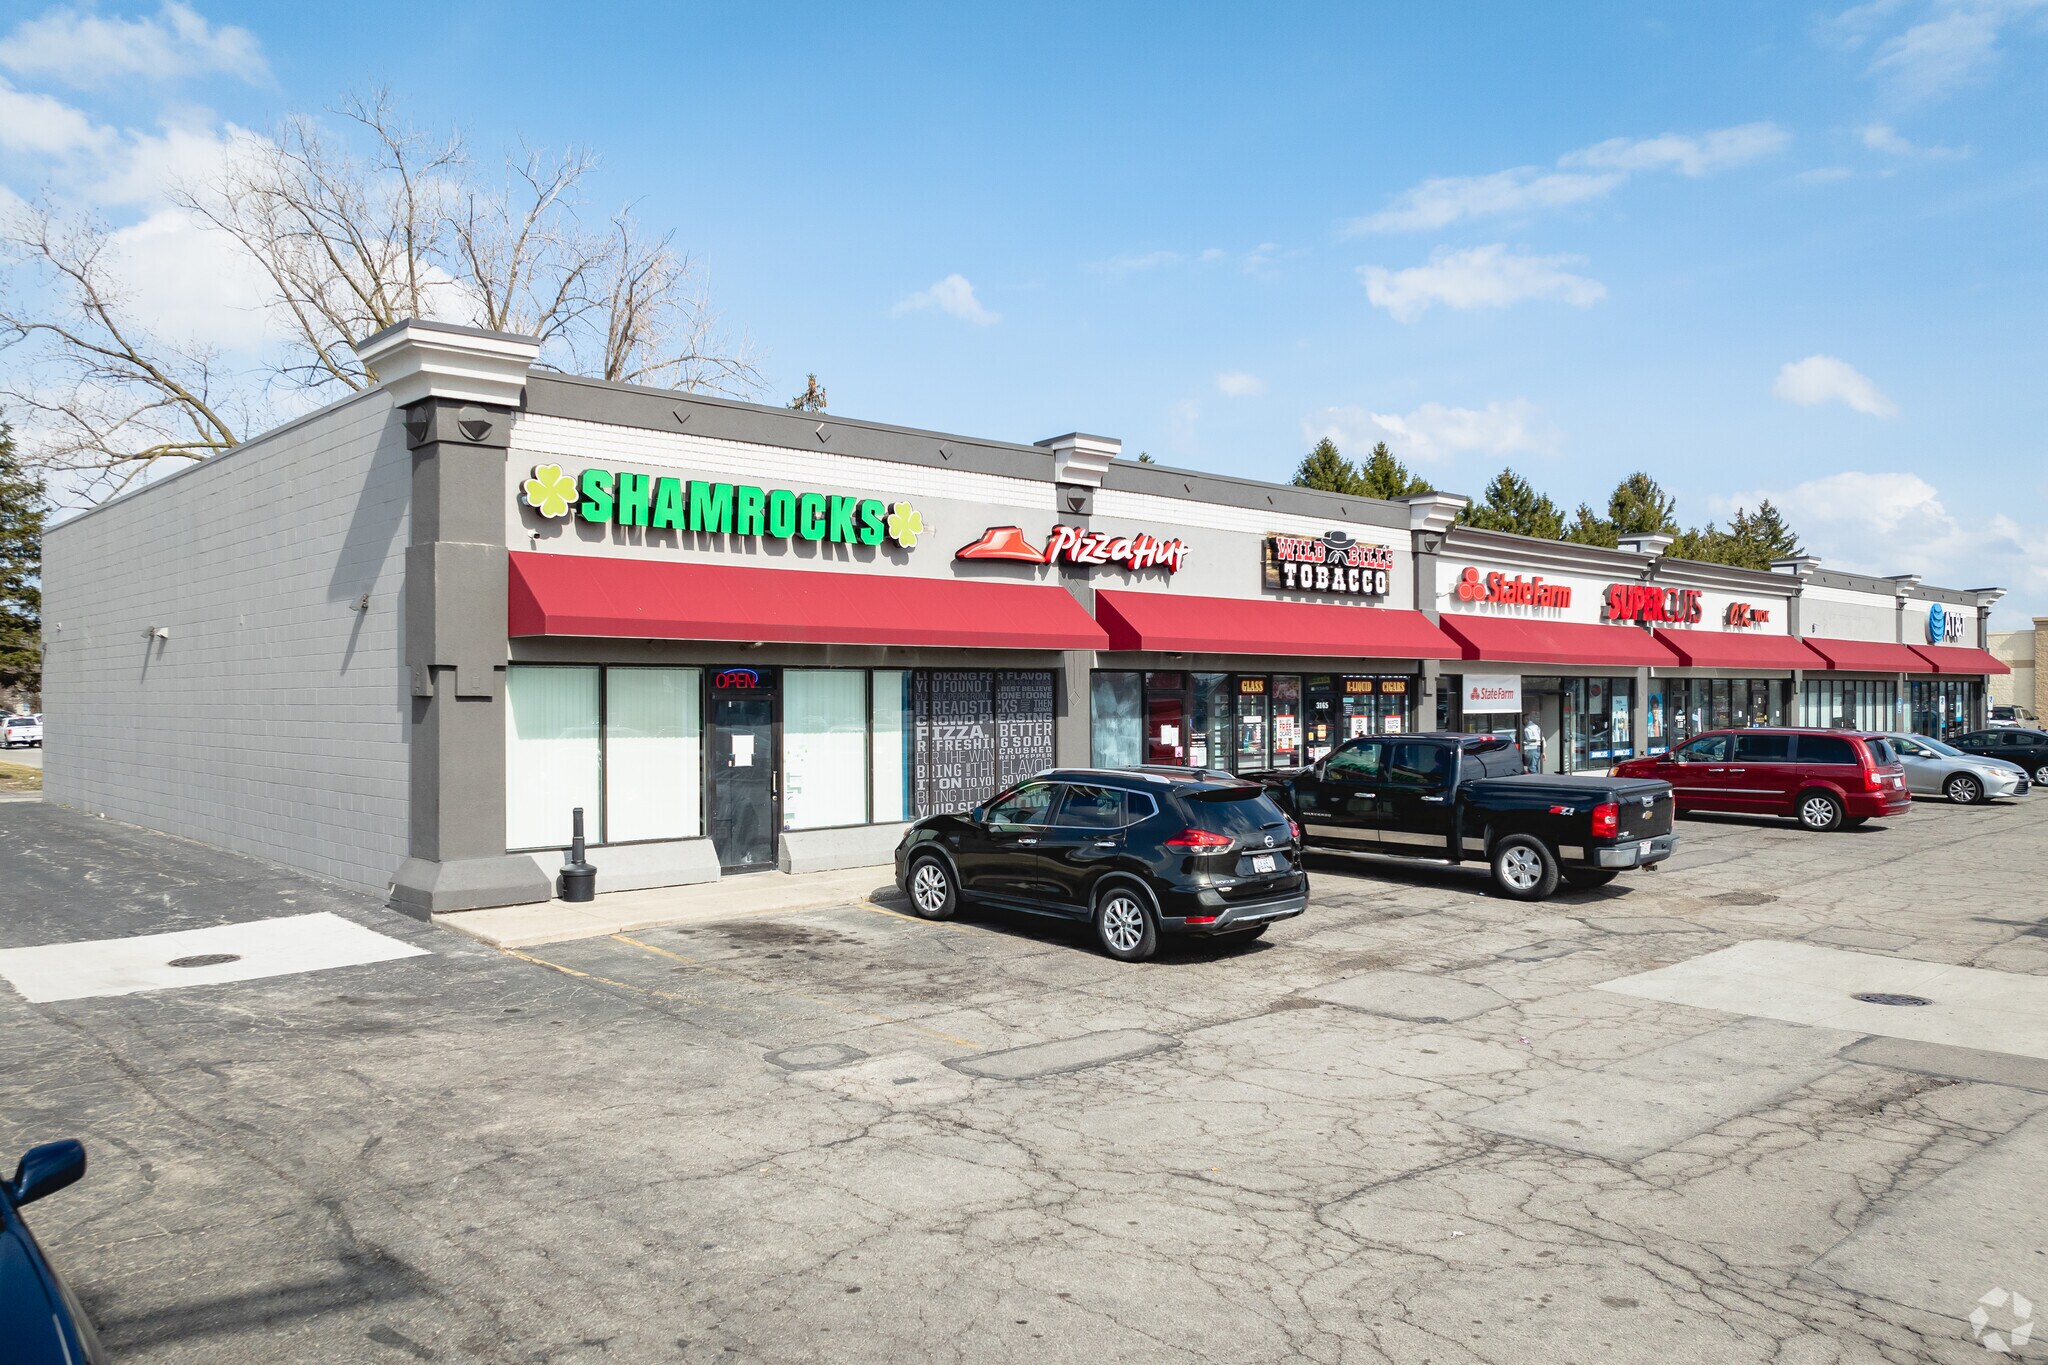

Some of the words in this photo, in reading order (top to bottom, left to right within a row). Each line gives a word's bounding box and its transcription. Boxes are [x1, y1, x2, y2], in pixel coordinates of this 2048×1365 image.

[578, 468, 885, 546] SHAMROCKS
[1048, 525, 1133, 565] Pizza
[1132, 534, 1193, 572] Hut
[1276, 536, 1326, 564] WILD
[1346, 544, 1395, 571] BILL'S
[1284, 562, 1386, 595] TOBACCO
[1608, 583, 1702, 624] SUPERCUTS
[1754, 609, 1770, 623] WOK
[1944, 611, 1966, 638] AT&T
[716, 673, 757, 689] OPEN
[1007, 672, 1051, 680] FLAVOR
[943, 680, 982, 692] FOUND
[1241, 681, 1264, 692] GLASS
[1346, 681, 1372, 692] E-LIQUID
[1382, 682, 1405, 692] CIGARS
[915, 693, 947, 701] CLSIC
[948, 692, 988, 700] PEPPERONI
[1034, 699, 1053, 708] THEN
[916, 725, 989, 741] PIZZA.
[999, 723, 1052, 737] BETTER
[1279, 723, 1292, 731] FREE
[917, 737, 1008, 752] RFRESHIG
[1013, 736, 1051, 747] SODA
[999, 746, 1052, 755] CRUSHED
[944, 750, 966, 764] THE
[969, 749, 995, 762] WIN
[1001, 758, 1053, 775] FLAVOR
[939, 778, 962, 789] ON
[965, 777, 977, 787] TO
[1001, 775, 1014, 784] SO
[960, 788, 973, 801] IT
[975, 786, 991, 800] TO
